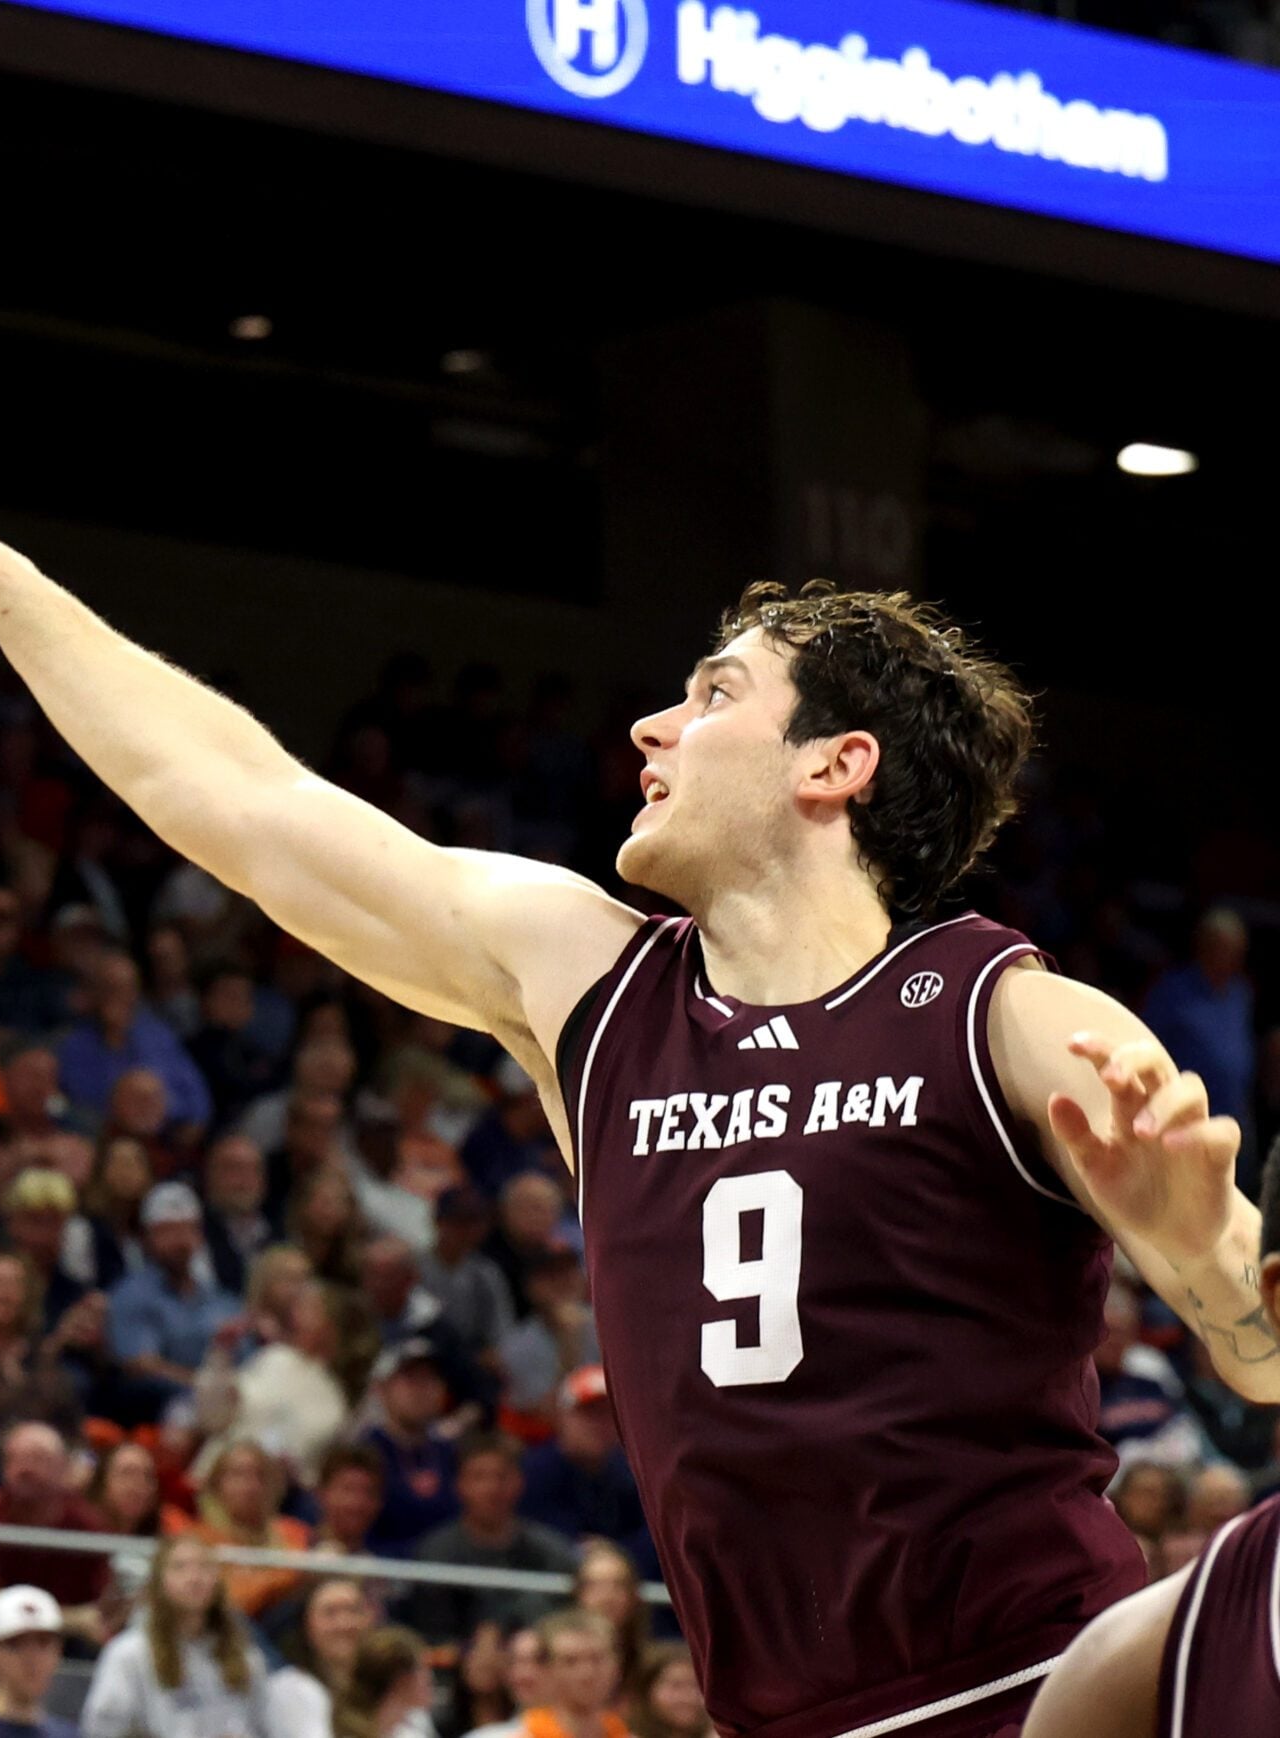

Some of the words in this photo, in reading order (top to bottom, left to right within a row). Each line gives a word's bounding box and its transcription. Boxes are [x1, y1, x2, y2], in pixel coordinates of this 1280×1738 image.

[676, 1, 1169, 182] Higginbotham
[901, 972, 943, 1007] SEC
[629, 1083, 791, 1156] TEXAS
[803, 1075, 925, 1136] A&M
[699, 1169, 805, 1388] 9
